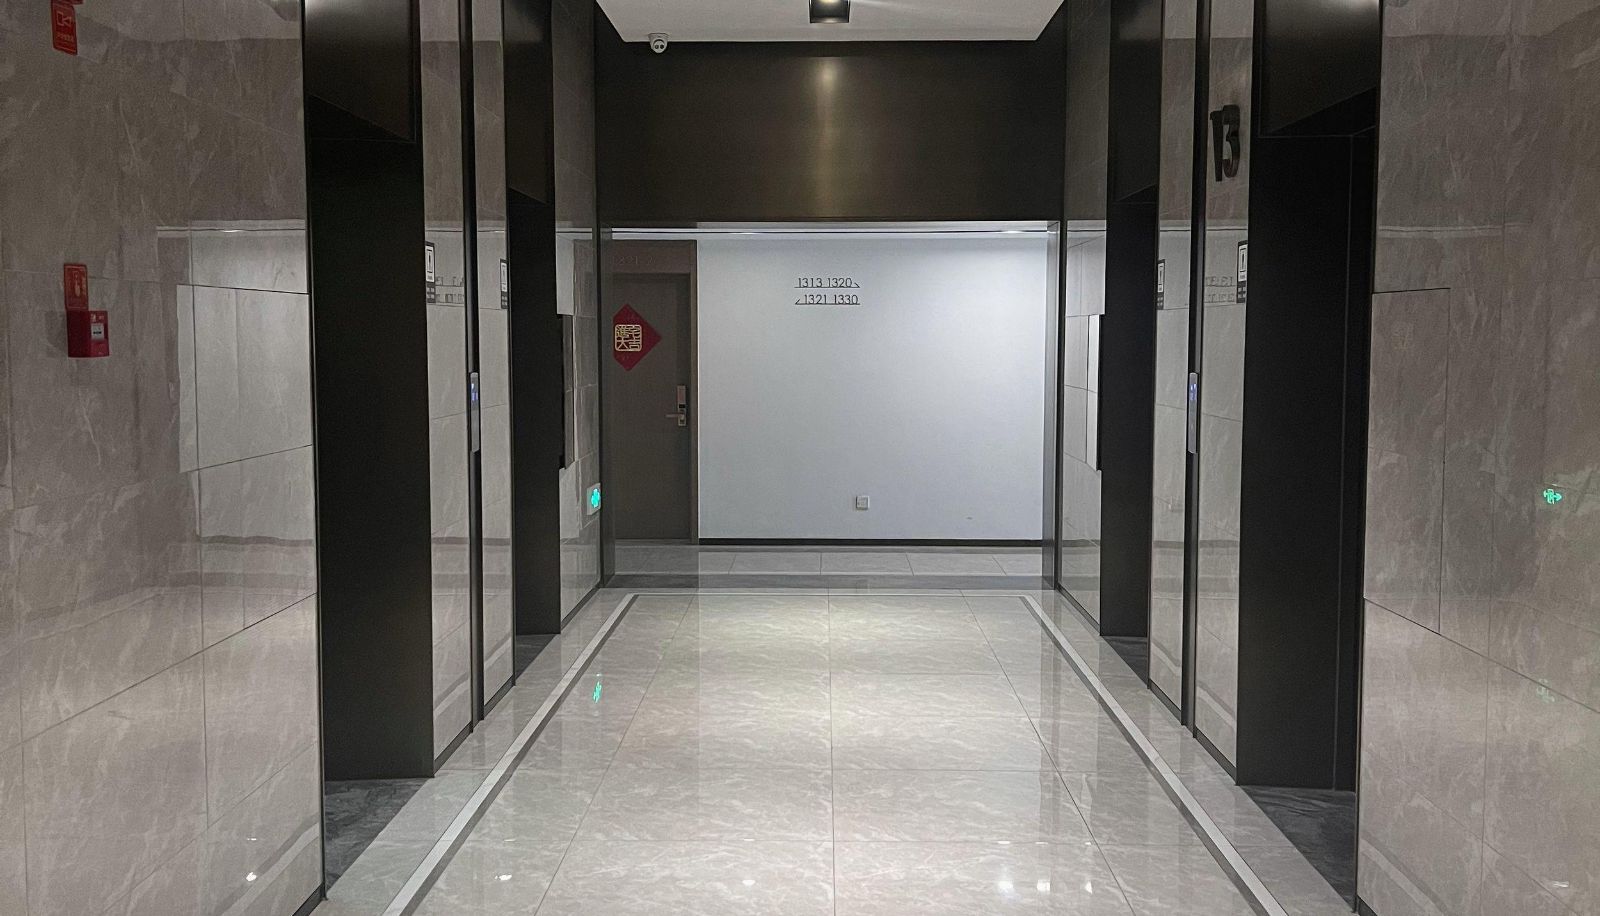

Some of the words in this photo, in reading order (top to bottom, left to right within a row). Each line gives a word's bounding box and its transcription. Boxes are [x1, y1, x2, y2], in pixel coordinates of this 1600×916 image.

[1210, 105, 1240, 182] 13
[798, 277, 824, 289] 1313
[827, 277, 853, 289] 1320
[804, 294, 828, 305] 1321
[834, 294, 859, 305] 1330
